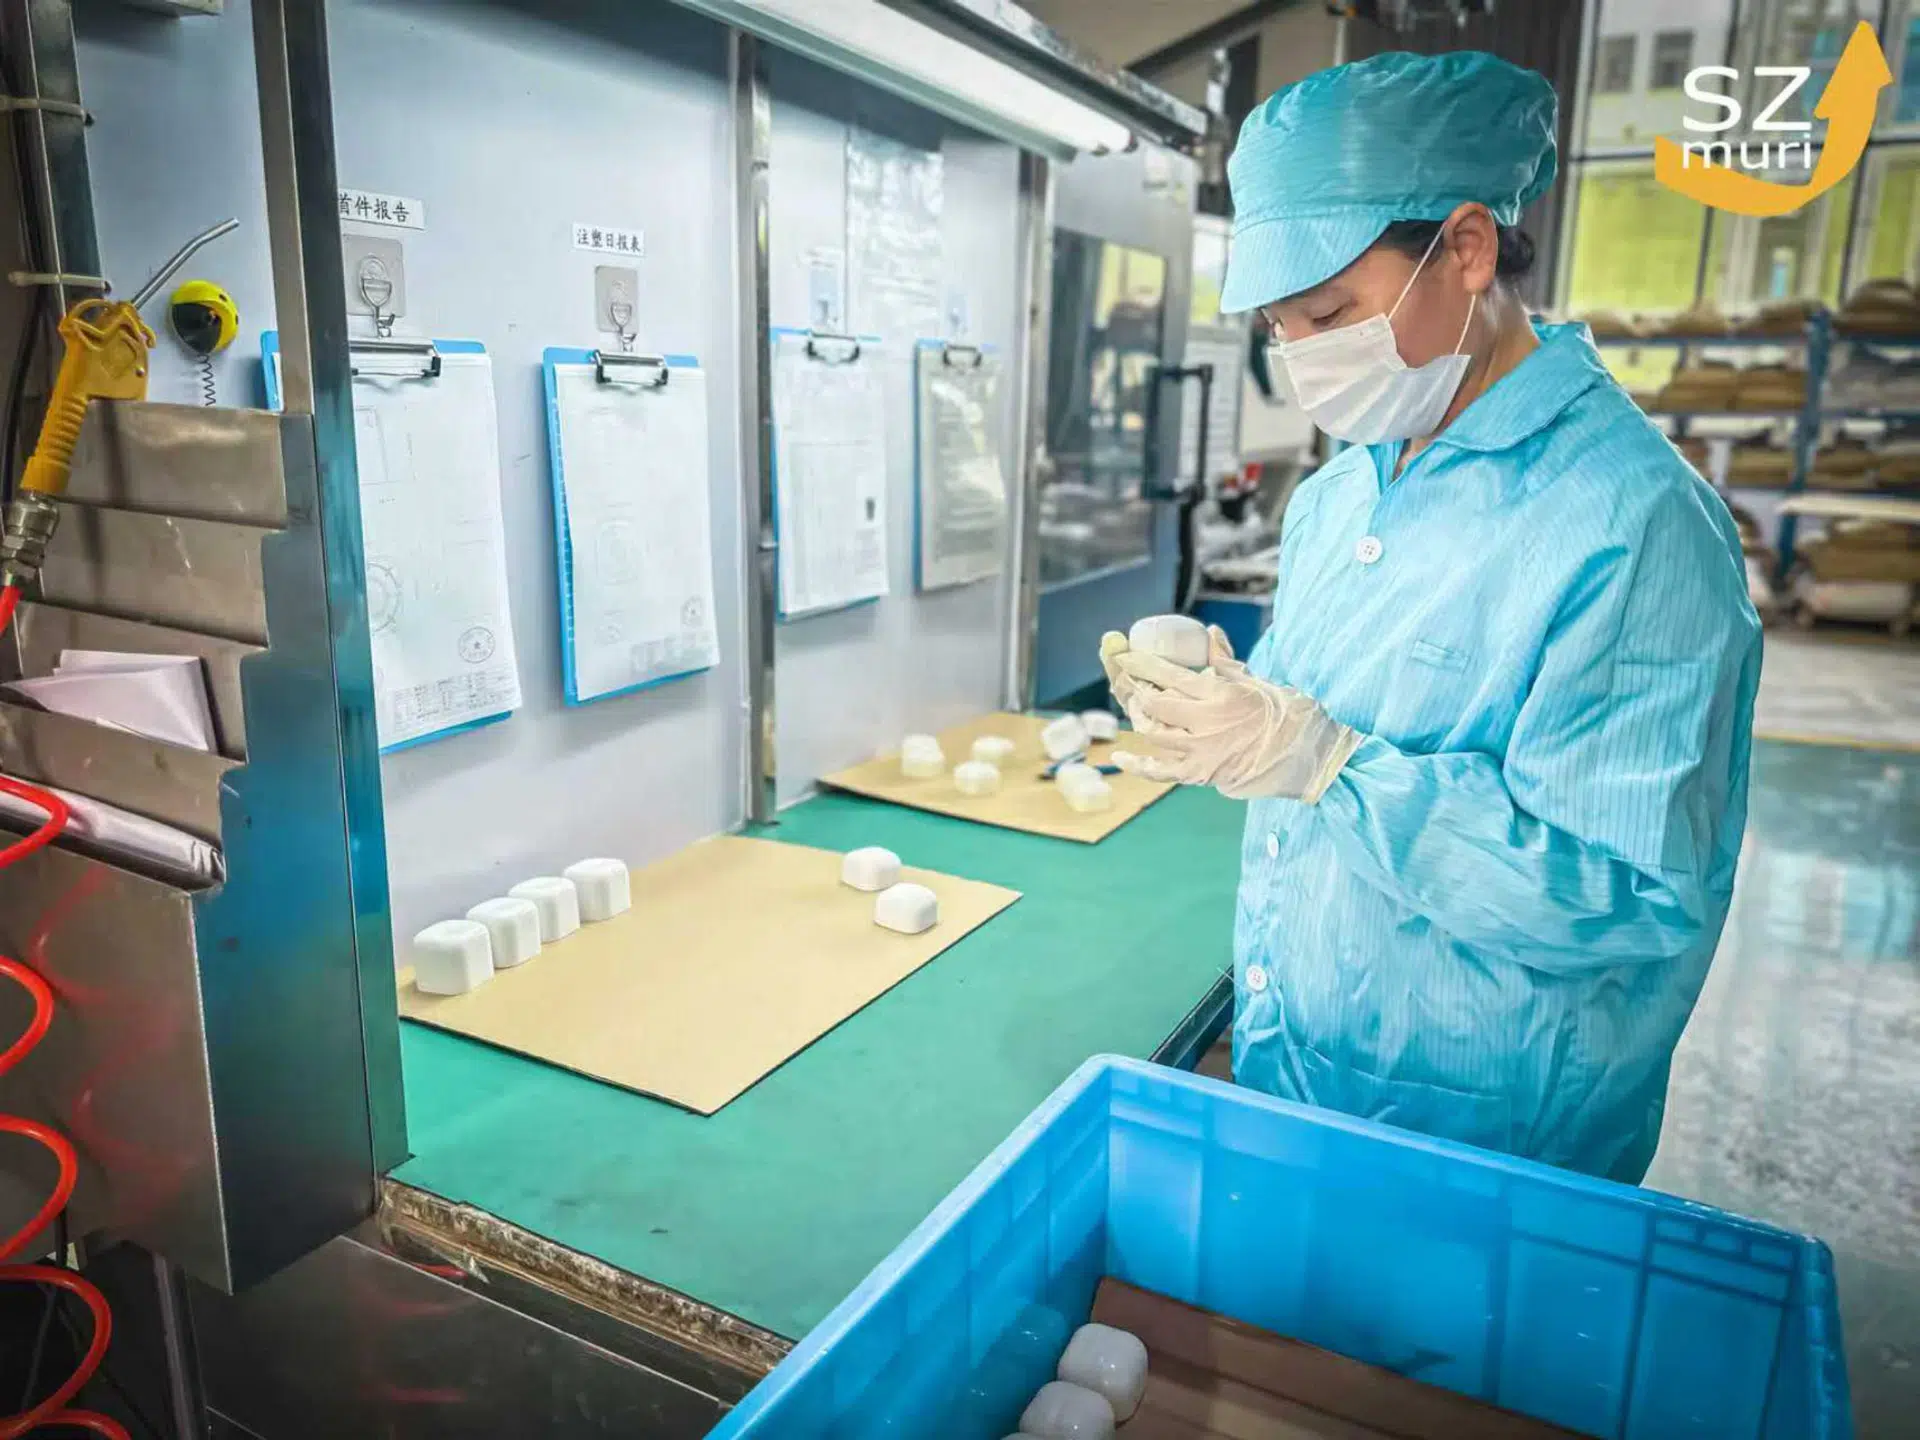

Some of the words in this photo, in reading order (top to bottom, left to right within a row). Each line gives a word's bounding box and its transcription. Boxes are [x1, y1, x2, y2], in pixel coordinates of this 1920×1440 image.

[339, 192, 410, 222] 首件报告
[577, 228, 641, 252] 注塑日报表
